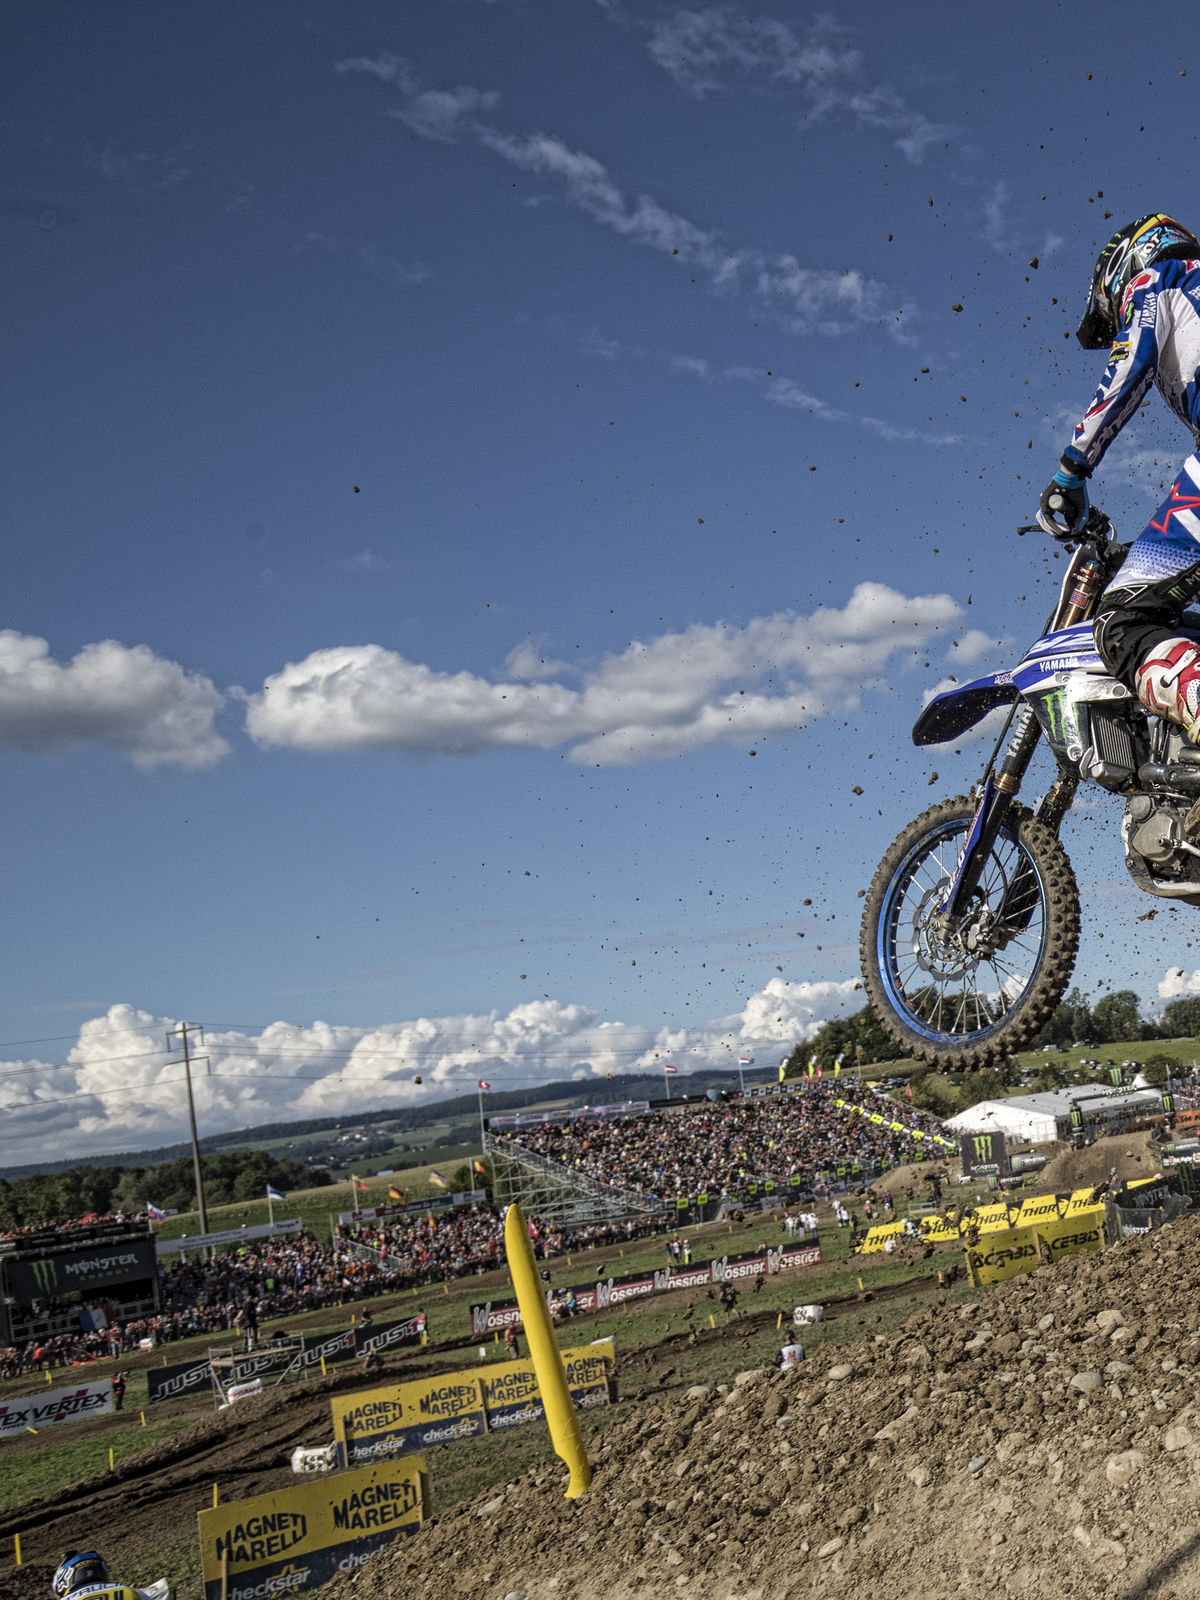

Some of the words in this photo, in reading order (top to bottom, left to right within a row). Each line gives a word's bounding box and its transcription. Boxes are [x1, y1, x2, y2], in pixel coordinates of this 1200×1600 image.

[1039, 656, 1080, 673] YAMAHA
[1022, 1204, 1058, 1218] THOR
[1050, 1230, 1100, 1251] CERBIS
[65, 1253, 138, 1275] MONSTER
[973, 1244, 1037, 1269] ACERBIS
[473, 1301, 523, 1333] Wössn
[711, 1255, 766, 1283] Wössner
[32, 1391, 111, 1419] VERTEX
[420, 1385, 477, 1414] MAGNETI
[486, 1372, 538, 1400] MAGNET
[422, 1421, 480, 1444] checkstar
[490, 1404, 545, 1429] checkstar
[333, 1482, 418, 1529] MAGNETI
[333, 1490, 418, 1530] MARELLI
[229, 1568, 312, 1600] heckstar
